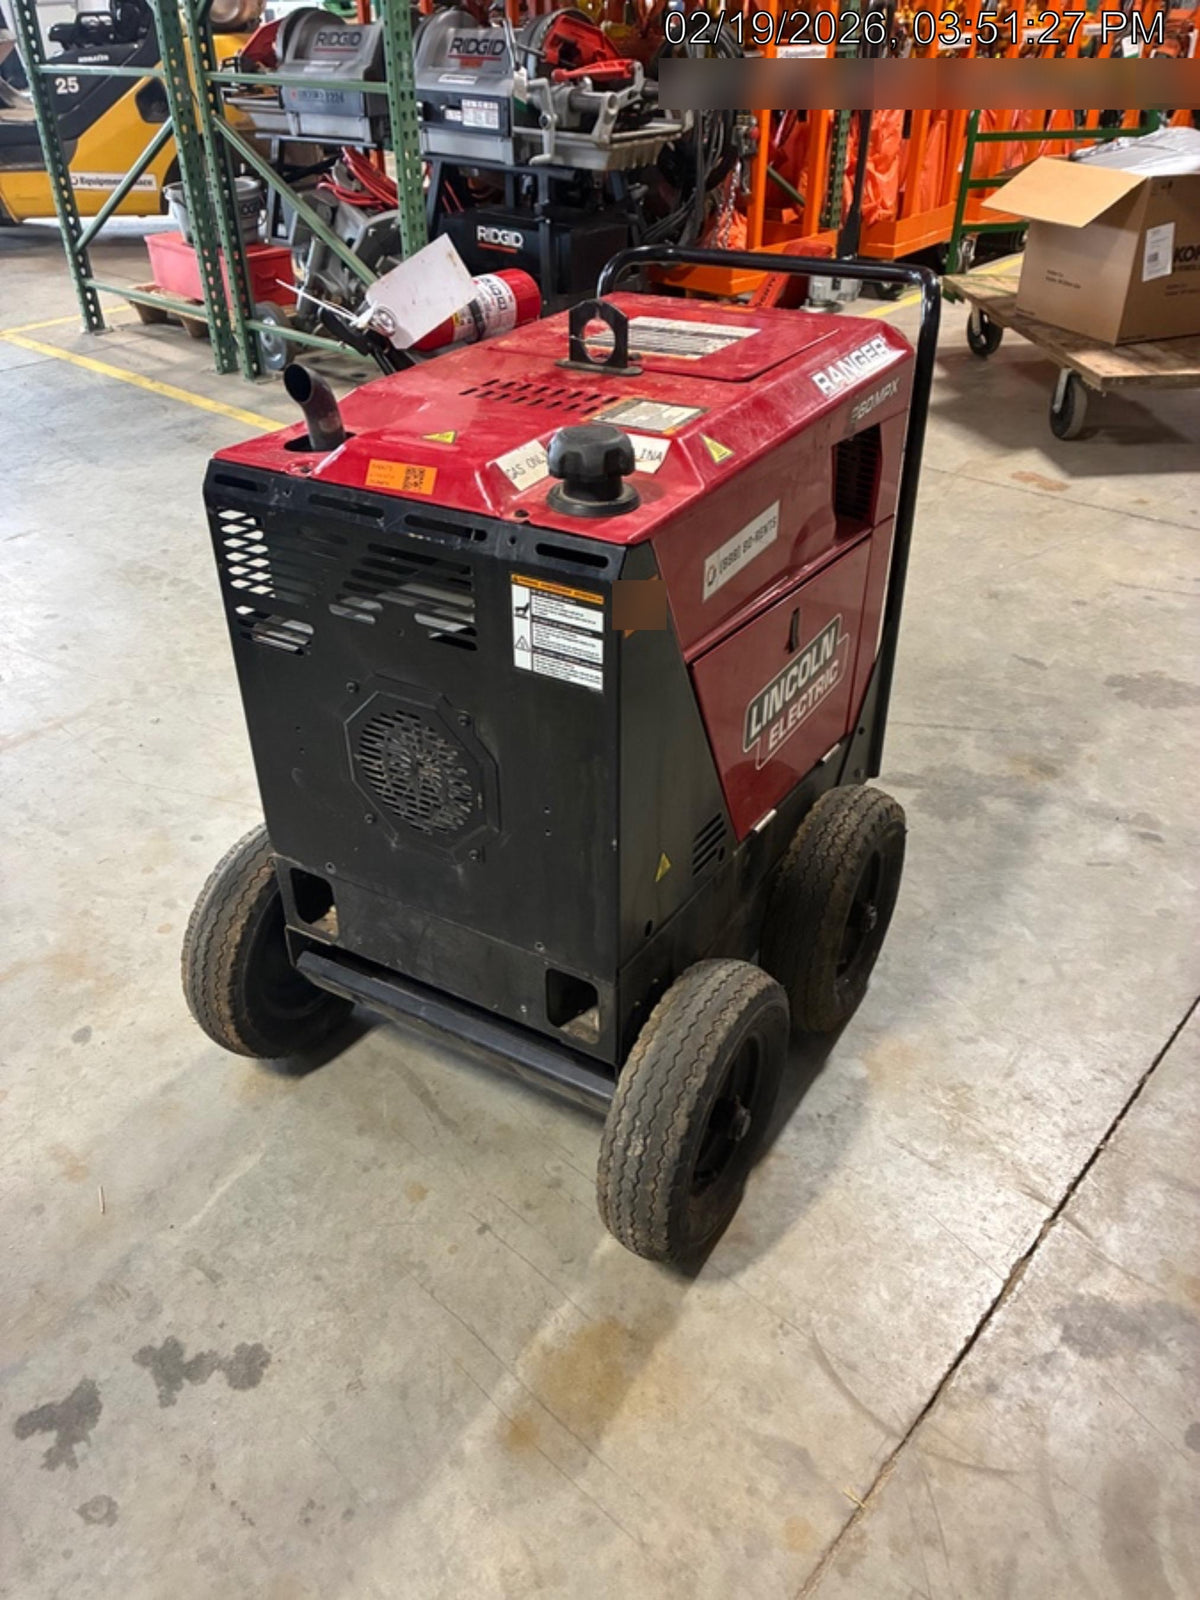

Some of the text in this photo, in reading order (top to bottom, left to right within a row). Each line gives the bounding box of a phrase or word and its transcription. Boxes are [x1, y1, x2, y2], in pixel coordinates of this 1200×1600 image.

[317, 31, 362, 47] RIDGID
[449, 36, 506, 56] RIDGID
[55, 76, 79, 94] 25
[477, 225, 524, 248] RIDGID
[811, 337, 892, 396] RANGER
[750, 626, 836, 738] LINCOLN
[768, 659, 840, 750] ELECTRIC
